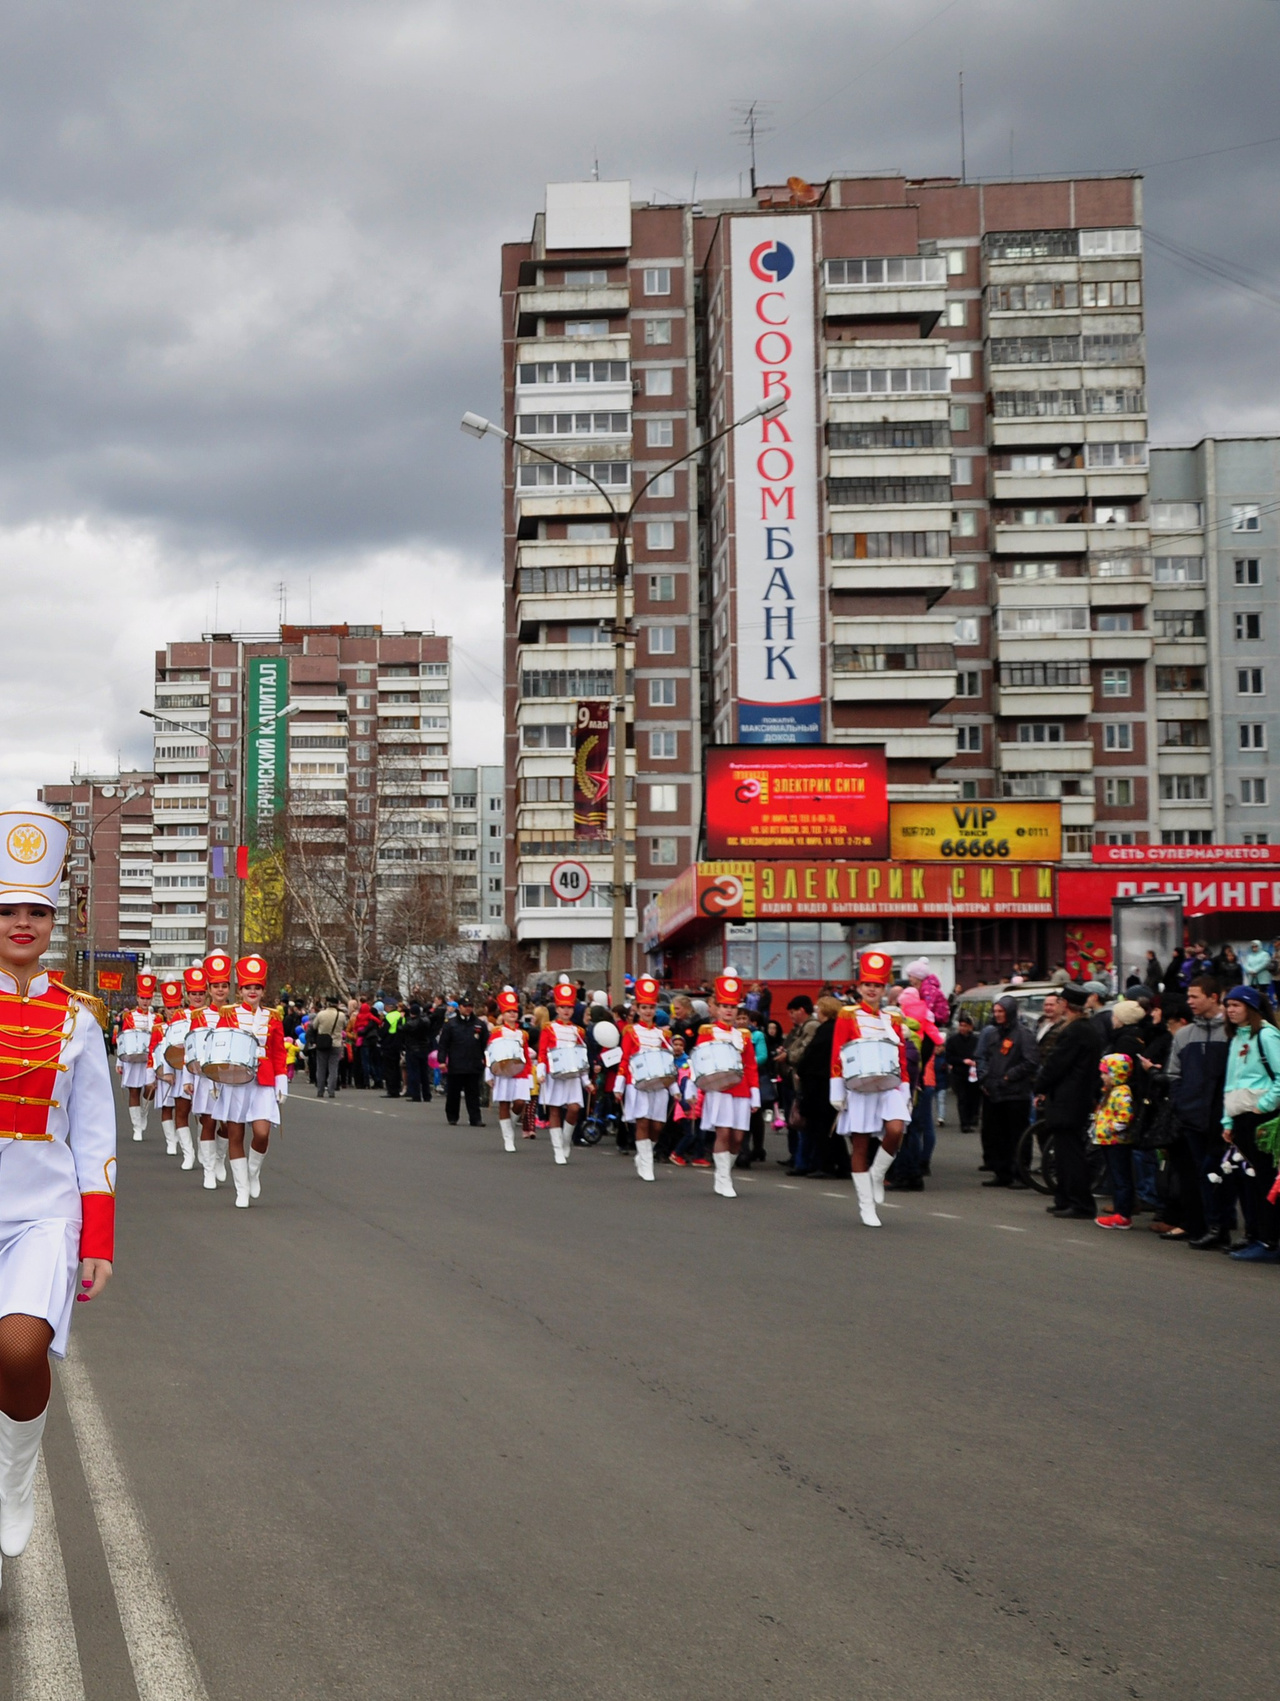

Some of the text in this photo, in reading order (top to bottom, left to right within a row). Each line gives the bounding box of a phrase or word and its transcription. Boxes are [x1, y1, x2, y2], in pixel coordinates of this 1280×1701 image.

[754, 291, 798, 681] СОВКОМБАНК
[258, 663, 277, 735] КАПИТАЛ
[578, 707, 609, 729] 9 мая
[740, 722, 819, 732] МАКСИМАЛЬНЫЙ
[763, 733, 797, 743] ДОХОД
[772, 778, 832, 793] ЭЛЕКТРИК
[835, 778, 866, 793] СИТИ
[952, 806, 997, 829] VIP
[940, 838, 1010, 857] 66666
[1109, 848, 1270, 859] СЕТЬ СУПЕРМАРКЕТОВ
[559, 871, 580, 889] 40
[761, 867, 1052, 899] ЭЛЕКТРИК СИТИ
[761, 902, 1052, 913] АУДИО ВИДЕО БЫТОВАЯ ТЕХНИКА КОМПЬЮТЕРЫ ОРГТЕХНИКА
